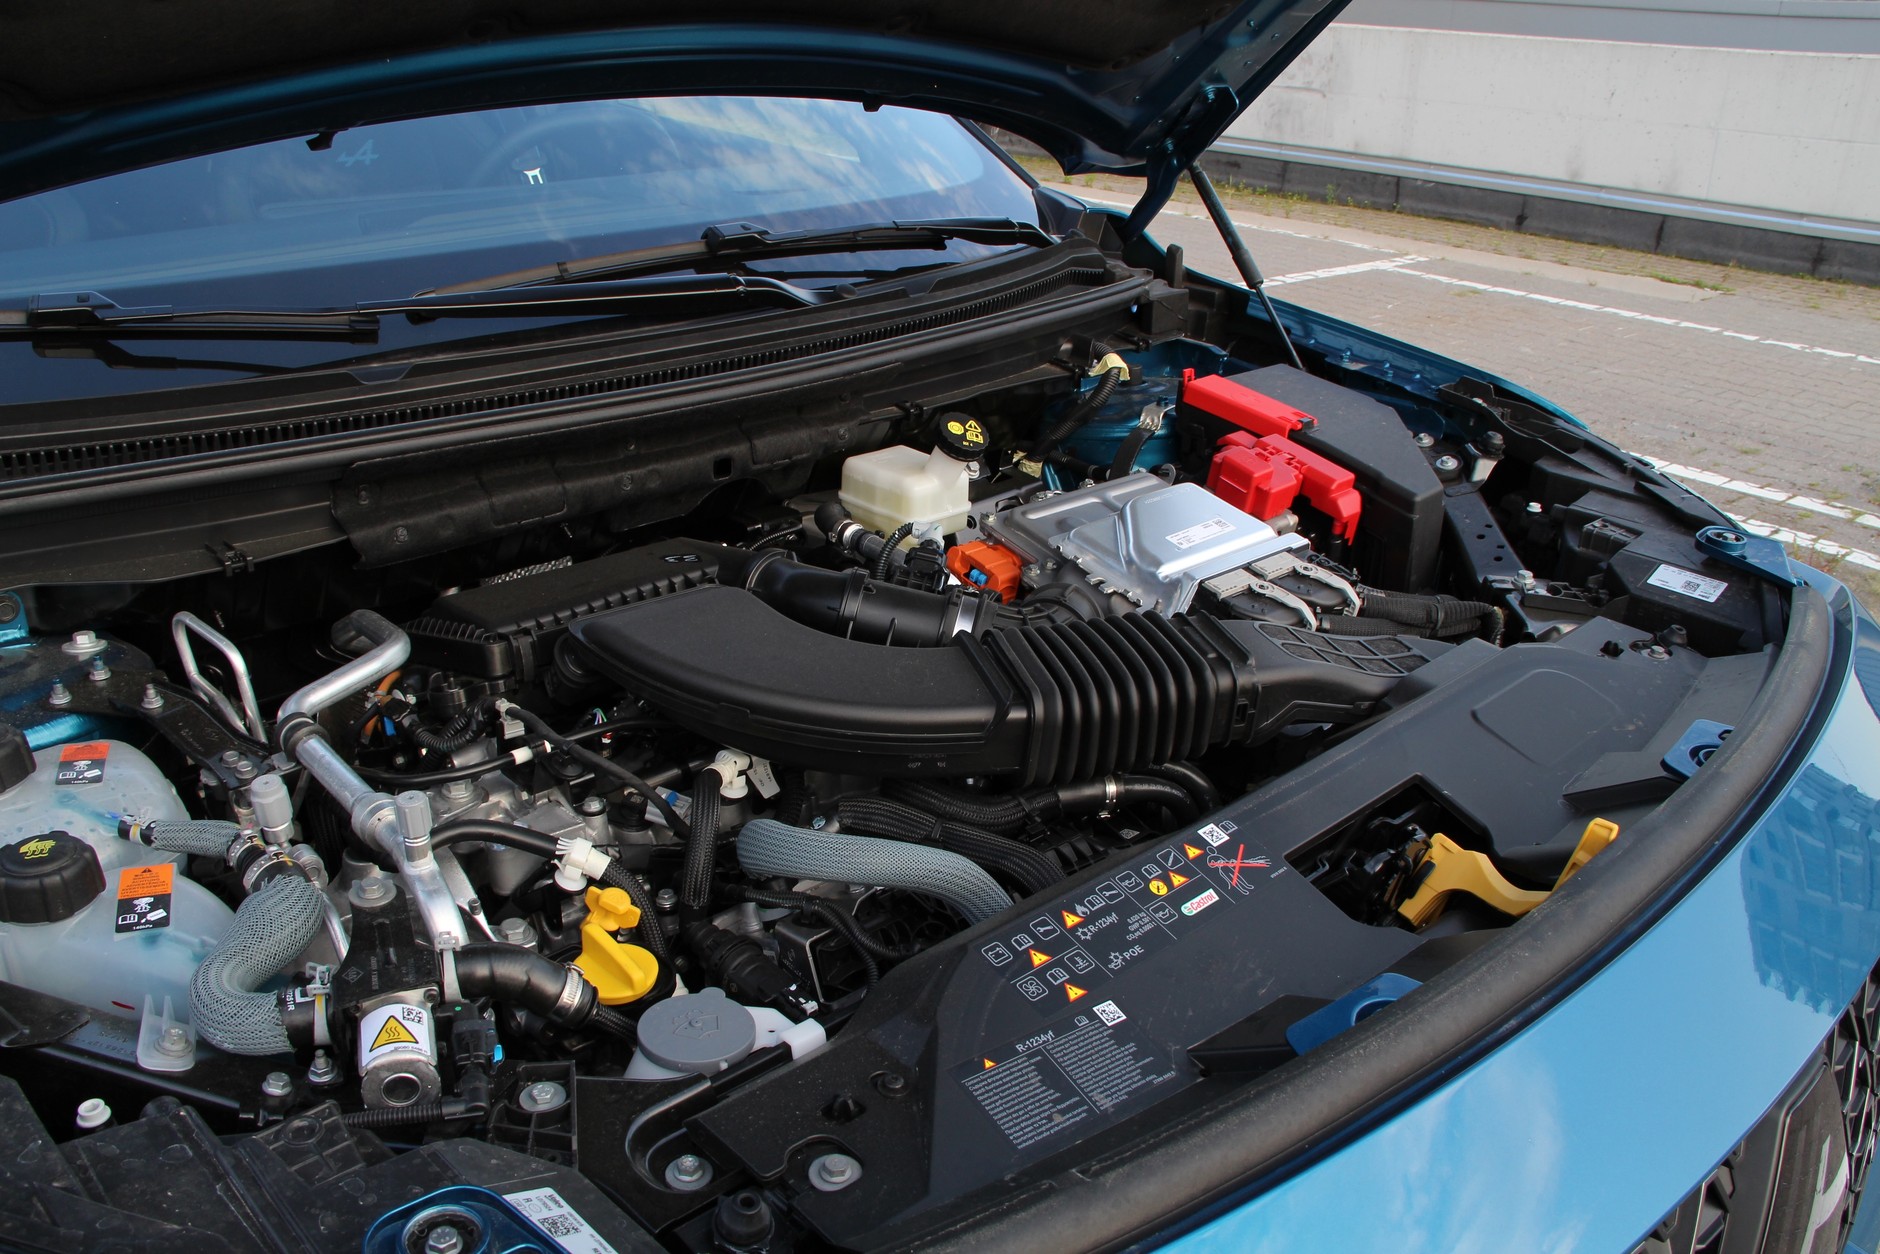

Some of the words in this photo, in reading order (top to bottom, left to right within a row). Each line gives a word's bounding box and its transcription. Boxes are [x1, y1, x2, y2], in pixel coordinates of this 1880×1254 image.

[1189, 891, 1216, 912] Castrol
[1088, 912, 1119, 934] R-1234yf
[1123, 944, 1144, 960] POE
[1015, 1029, 1056, 1053] R-1234yf
